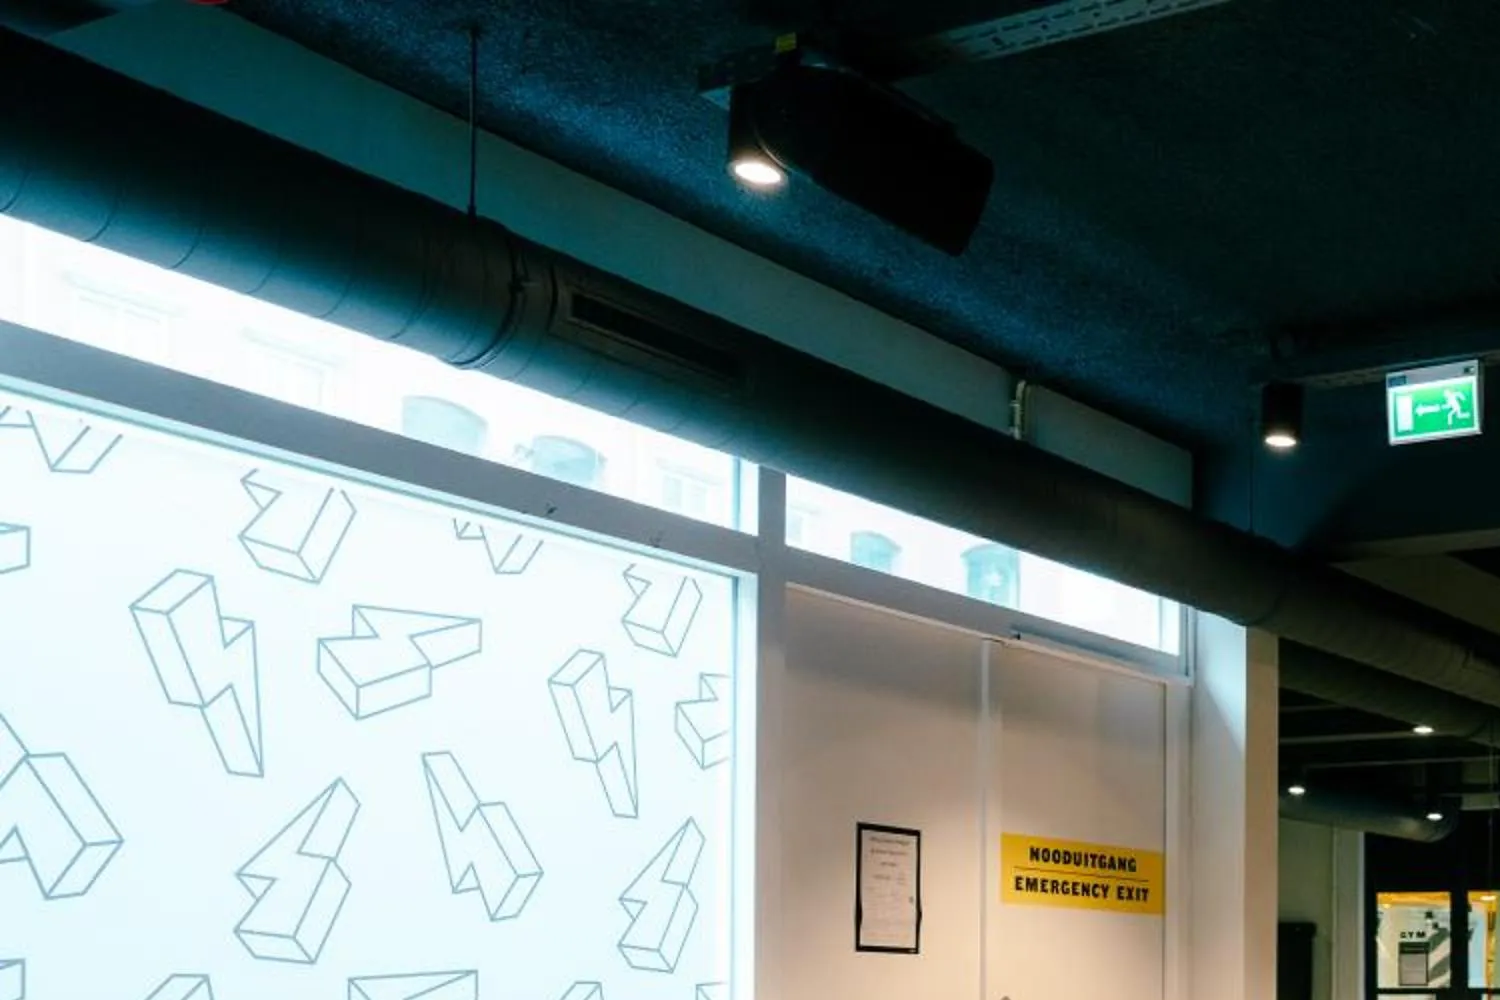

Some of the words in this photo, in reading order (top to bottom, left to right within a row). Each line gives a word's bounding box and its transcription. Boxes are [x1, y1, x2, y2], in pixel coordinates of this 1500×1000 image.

[1029, 846, 1137, 872] NOODUITGANG
[1015, 876, 1110, 899] EMERGENCY
[1117, 886, 1149, 902] EXIT
